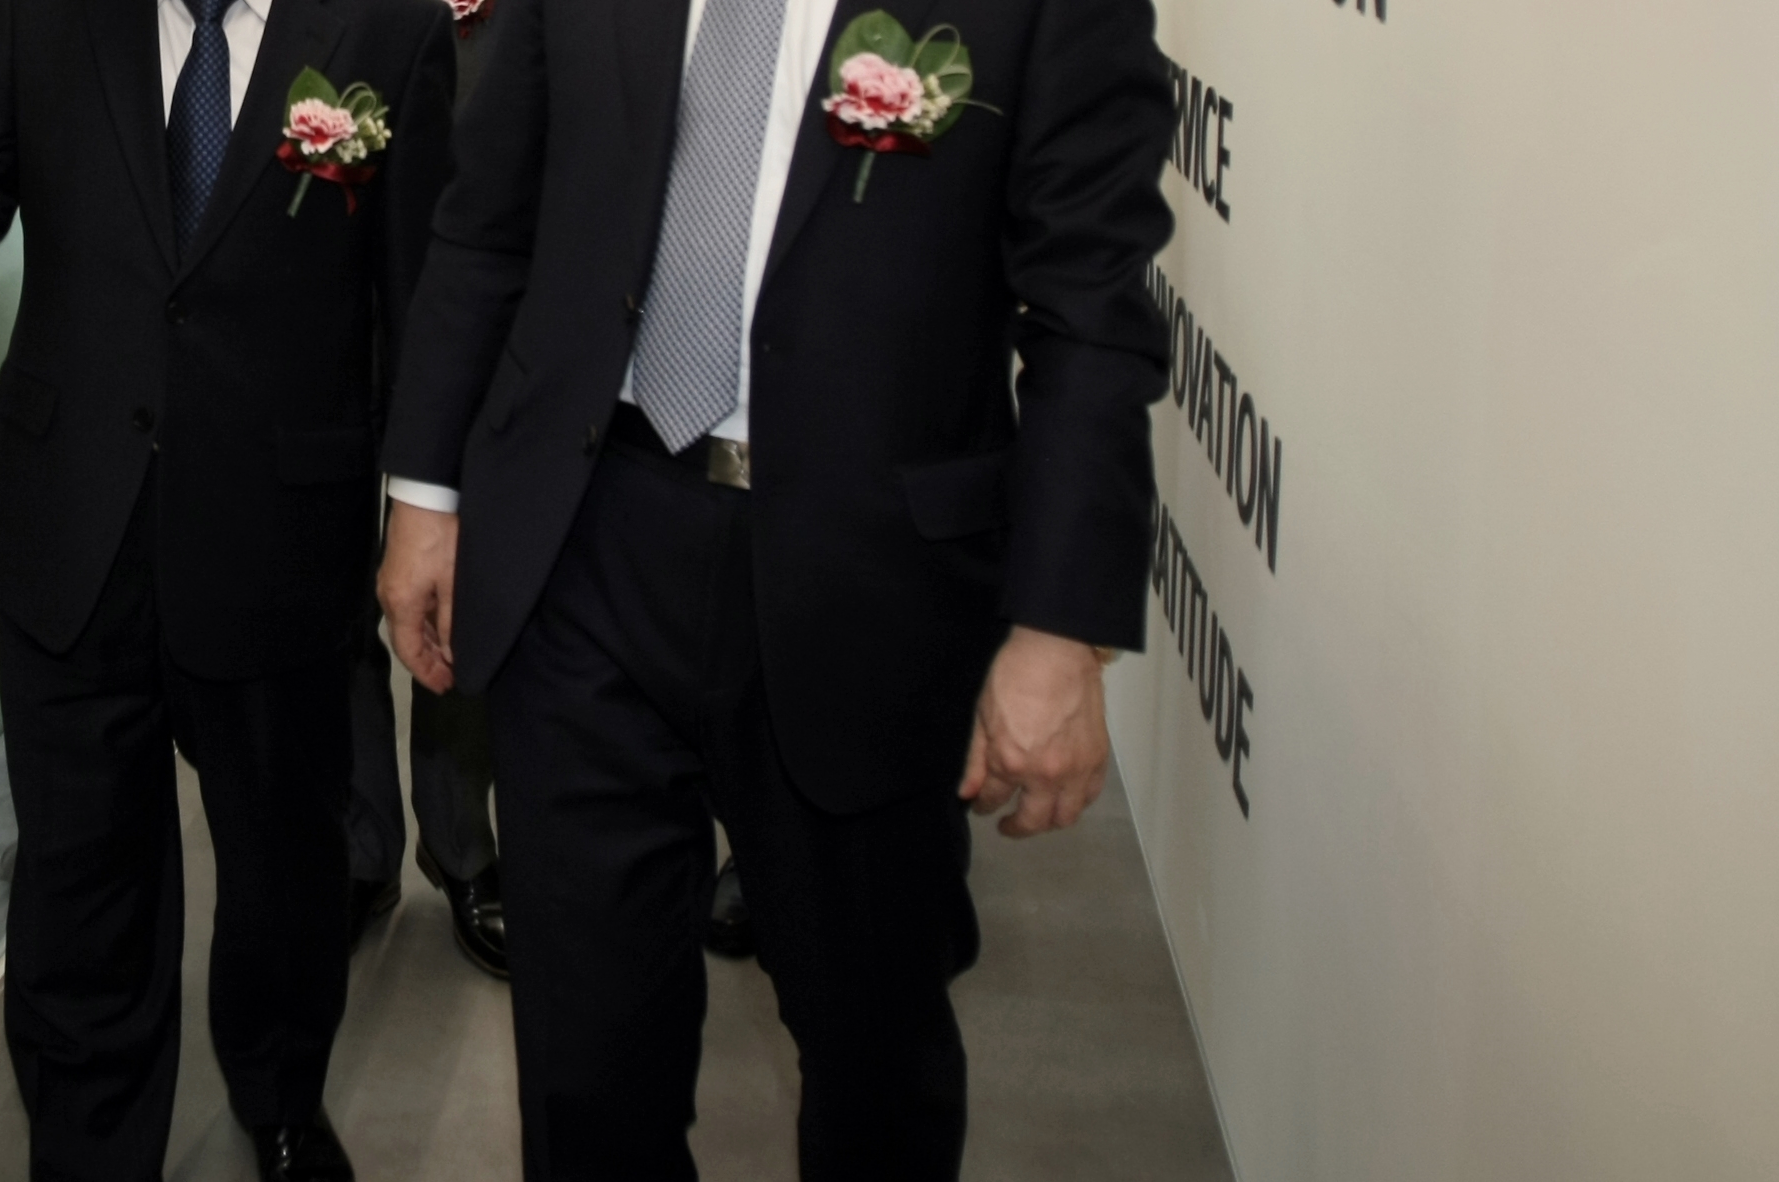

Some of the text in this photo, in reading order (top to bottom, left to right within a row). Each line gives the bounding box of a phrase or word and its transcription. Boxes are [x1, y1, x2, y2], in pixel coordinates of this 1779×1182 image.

[1168, 59, 1234, 225] RVICE
[1146, 258, 1282, 576] OVATION
[1152, 493, 1254, 821] ATITUDE
